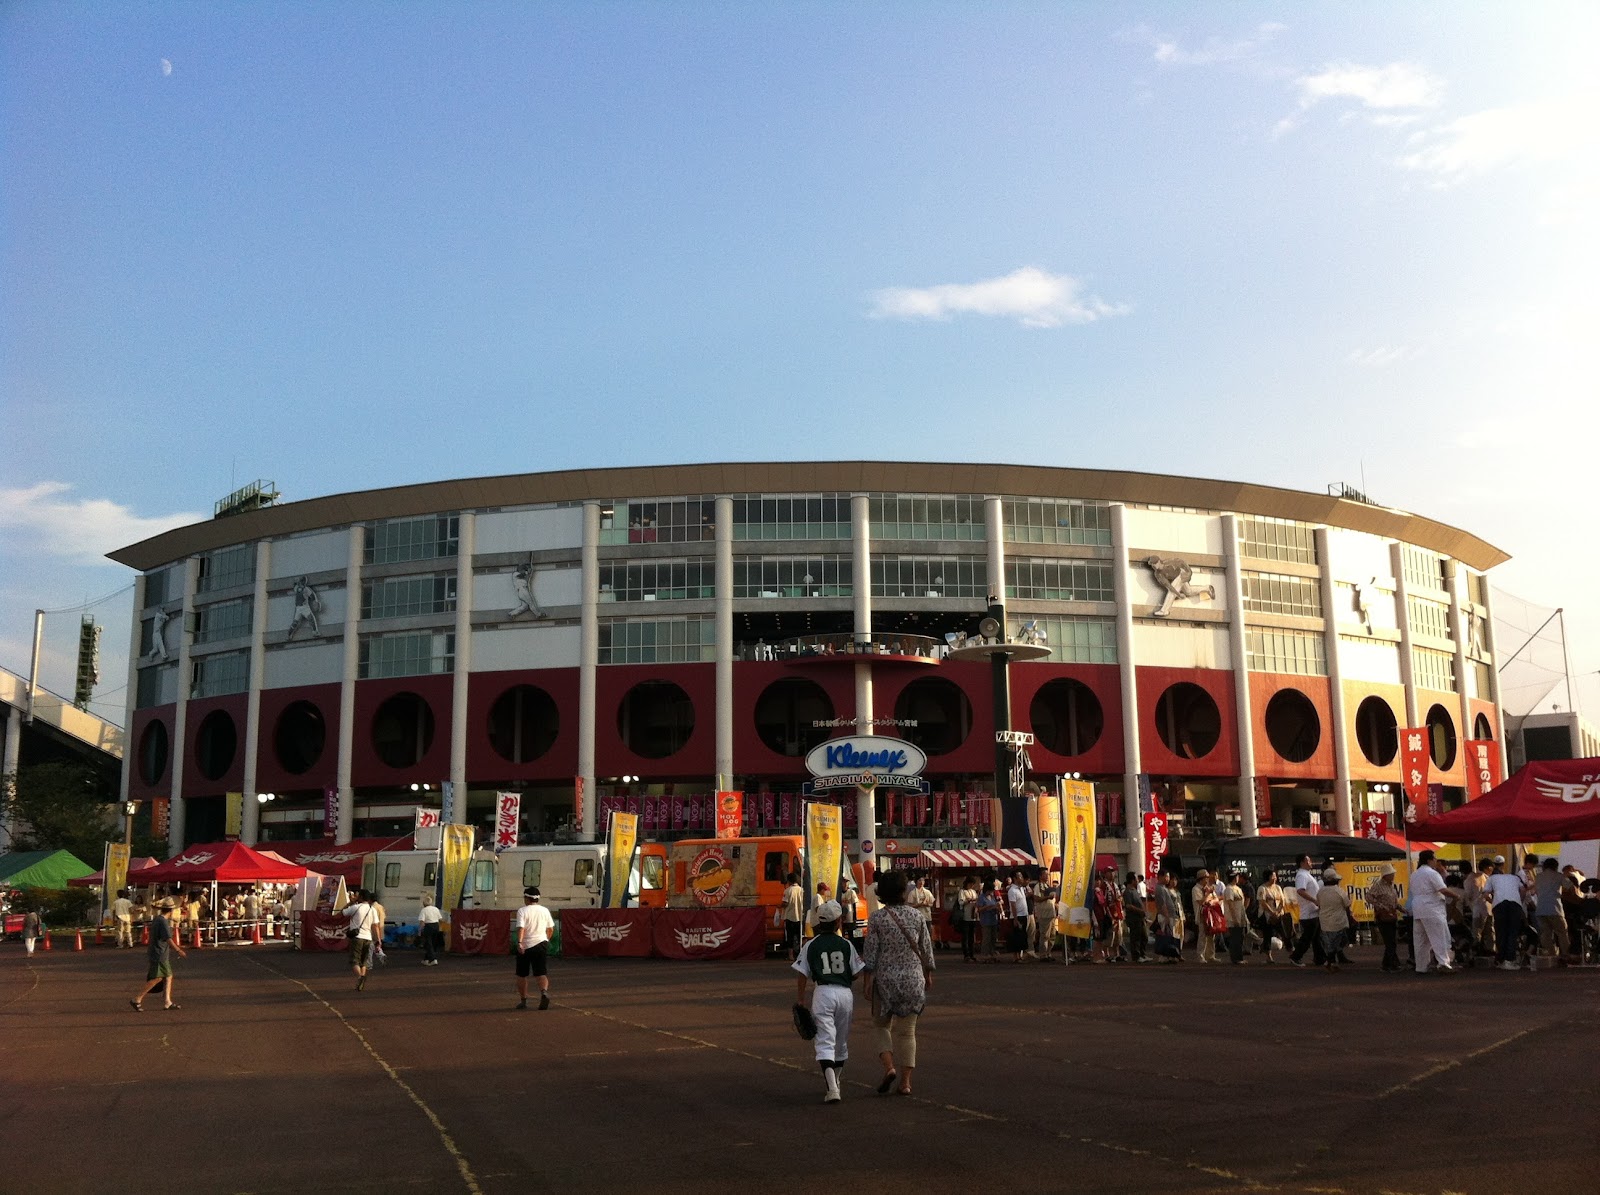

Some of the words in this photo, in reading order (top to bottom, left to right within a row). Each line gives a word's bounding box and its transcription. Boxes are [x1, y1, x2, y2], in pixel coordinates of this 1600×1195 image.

[826, 742, 908, 773] Kleenex
[814, 774, 873, 788] STADIUM
[876, 774, 920, 787] MIYAGI
[1347, 883, 1404, 900] PREM
[586, 923, 628, 942] EAGLES
[677, 930, 728, 949] EAGLES
[820, 951, 845, 975] 18
